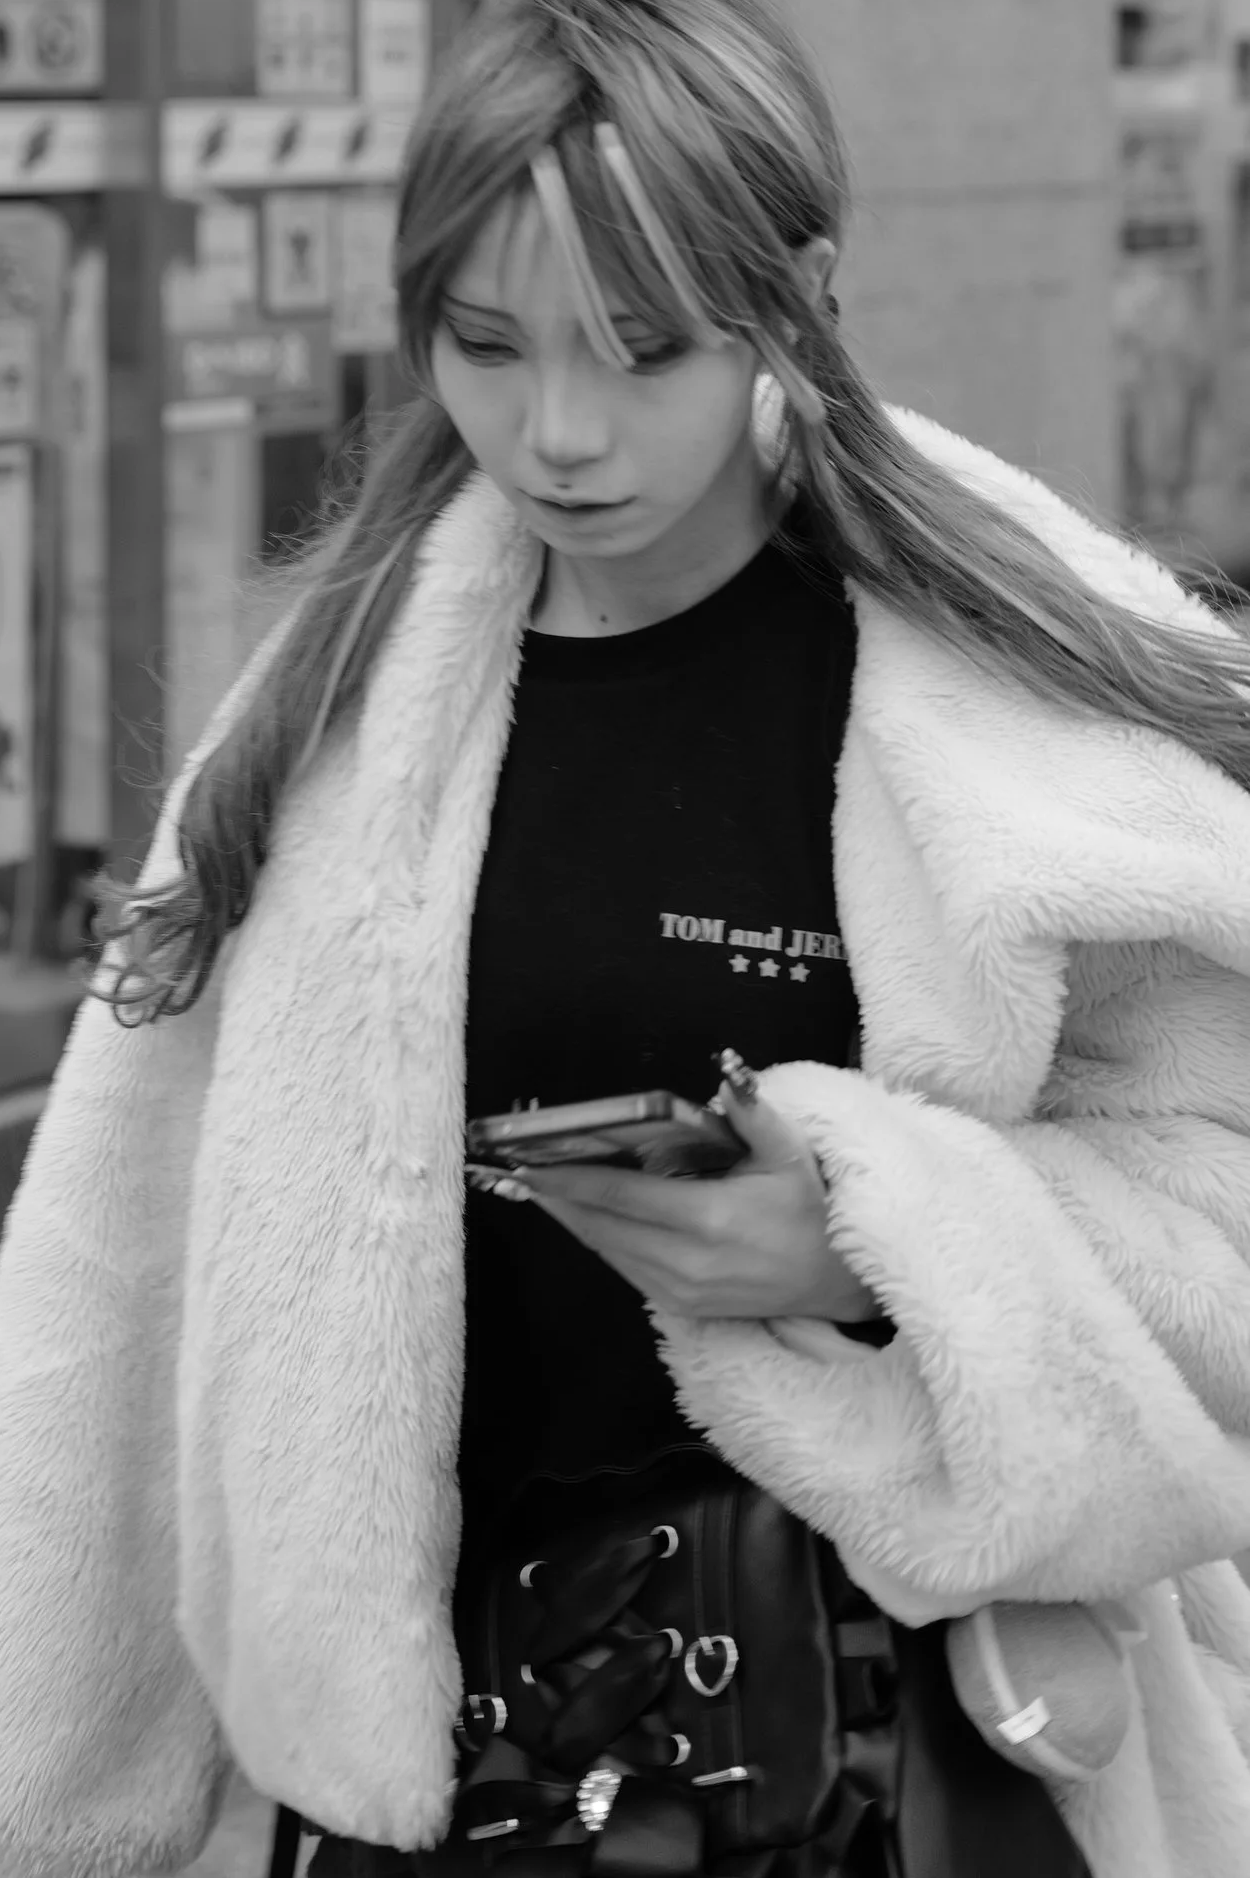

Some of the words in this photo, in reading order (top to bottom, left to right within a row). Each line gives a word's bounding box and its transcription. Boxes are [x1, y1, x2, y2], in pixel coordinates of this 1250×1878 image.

[659, 912, 727, 944] TOM
[727, 926, 783, 951] and
[784, 929, 850, 961] JER
